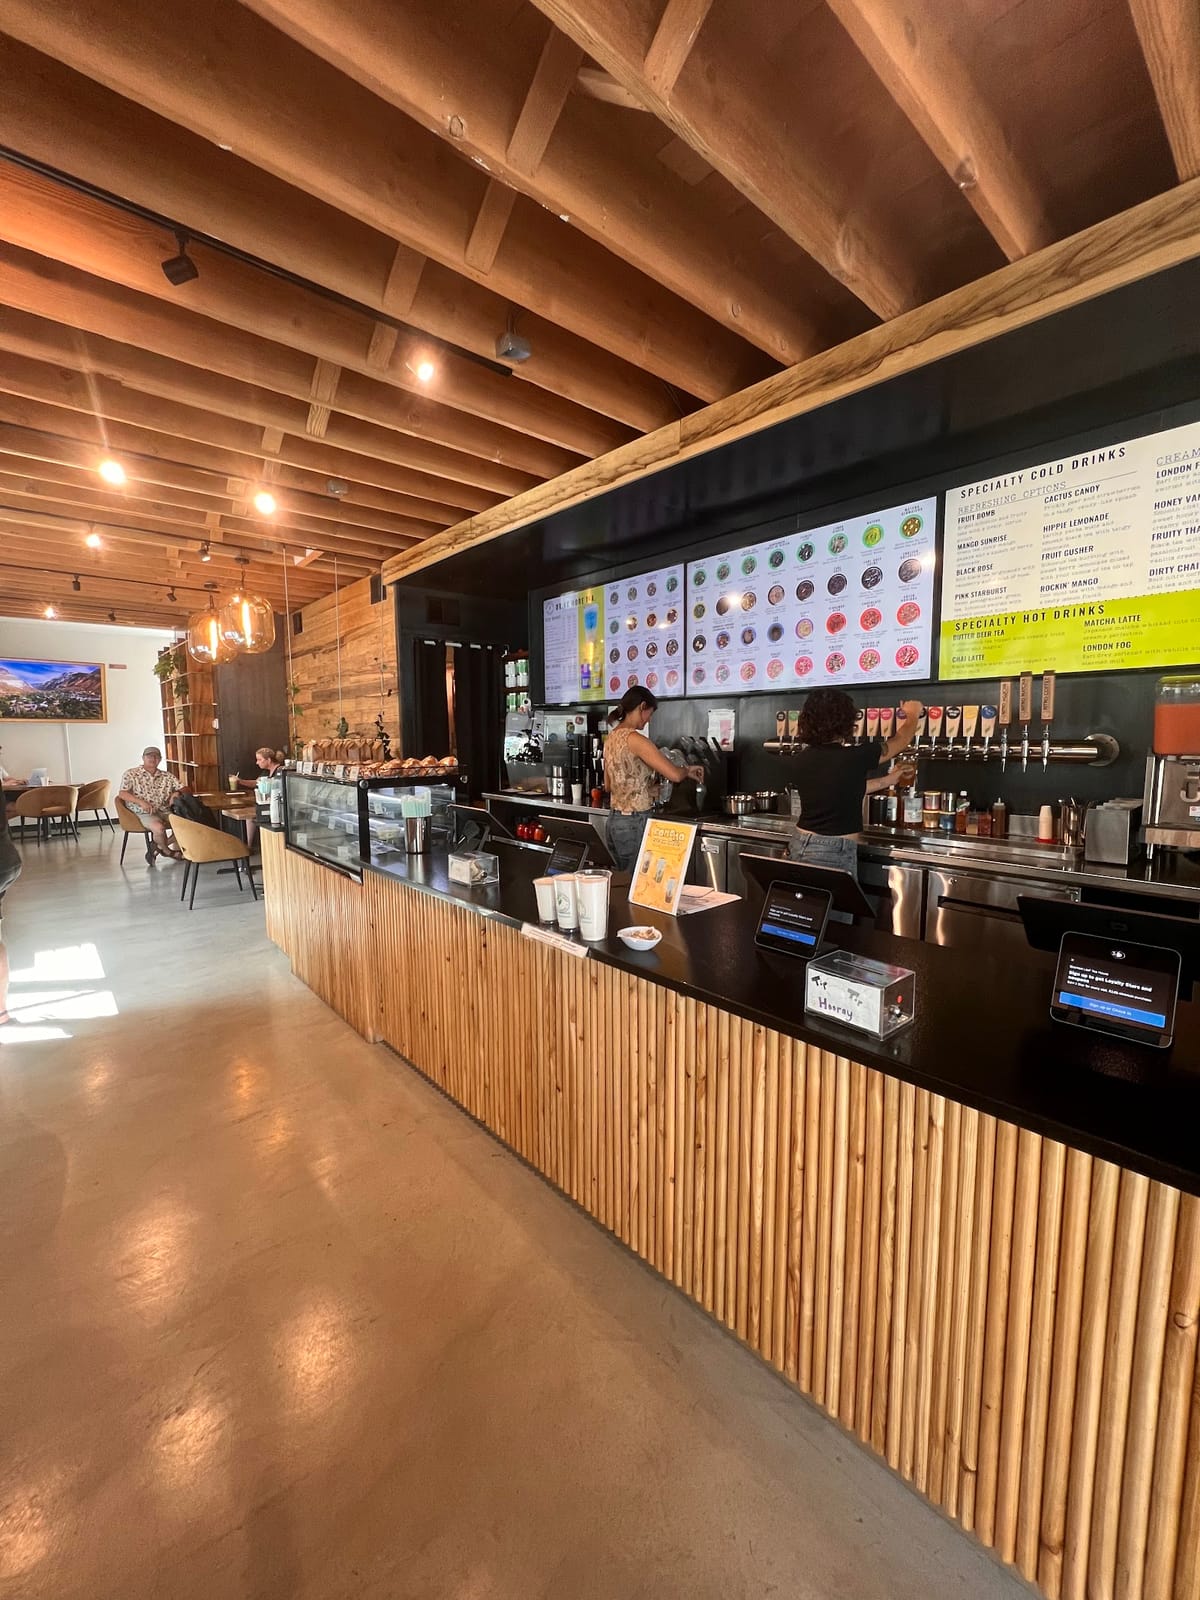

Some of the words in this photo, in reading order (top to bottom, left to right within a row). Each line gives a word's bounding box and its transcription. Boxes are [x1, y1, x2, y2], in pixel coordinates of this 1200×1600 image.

[960, 474, 1023, 498] SPECIALTY
[1031, 463, 1063, 480] COLD
[1071, 446, 1125, 470] DRINKS
[1156, 463, 1191, 479] LONDON
[958, 493, 1016, 514] REFRESHING
[1023, 480, 1066, 498] OPTIONS
[1044, 490, 1072, 504] CACTUS
[1074, 484, 1099, 497] CANDY
[1154, 496, 1182, 509] HONEY
[957, 514, 974, 524] FRUIT
[976, 509, 995, 519] BOMB
[1043, 521, 1066, 532] HIPPIE
[1069, 512, 1109, 527] LEMONADE
[957, 540, 978, 550] MANGO
[980, 534, 1007, 545] SUNRISE
[1151, 528, 1182, 541] FRUITY
[1041, 550, 1061, 560] FRUIT
[1063, 544, 1093, 556] GUSHER
[956, 566, 975, 576] BLACK
[977, 563, 992, 572] ROSE
[1149, 566, 1174, 576] DIRTY
[1177, 562, 1199, 572] CHAI
[970, 586, 1006, 597] STARBURST
[1040, 581, 1069, 592] ROCKIN'
[1071, 577, 1098, 587] MANGO
[955, 615, 1016, 631] SPECIALTY
[1023, 611, 1046, 623] HOT
[1054, 604, 1104, 619] DRINKS
[1084, 616, 1115, 627] MATCHA
[1118, 613, 1141, 623] LATTE
[952, 632, 974, 641] BUTTER
[976, 630, 991, 638] BEER
[1082, 642, 1113, 652] LONDON
[1115, 640, 1131, 649] FOG
[812, 976, 828, 990] Tip
[1105, 978, 1124, 987] Loyalty
[818, 996, 853, 1021] Hooray
